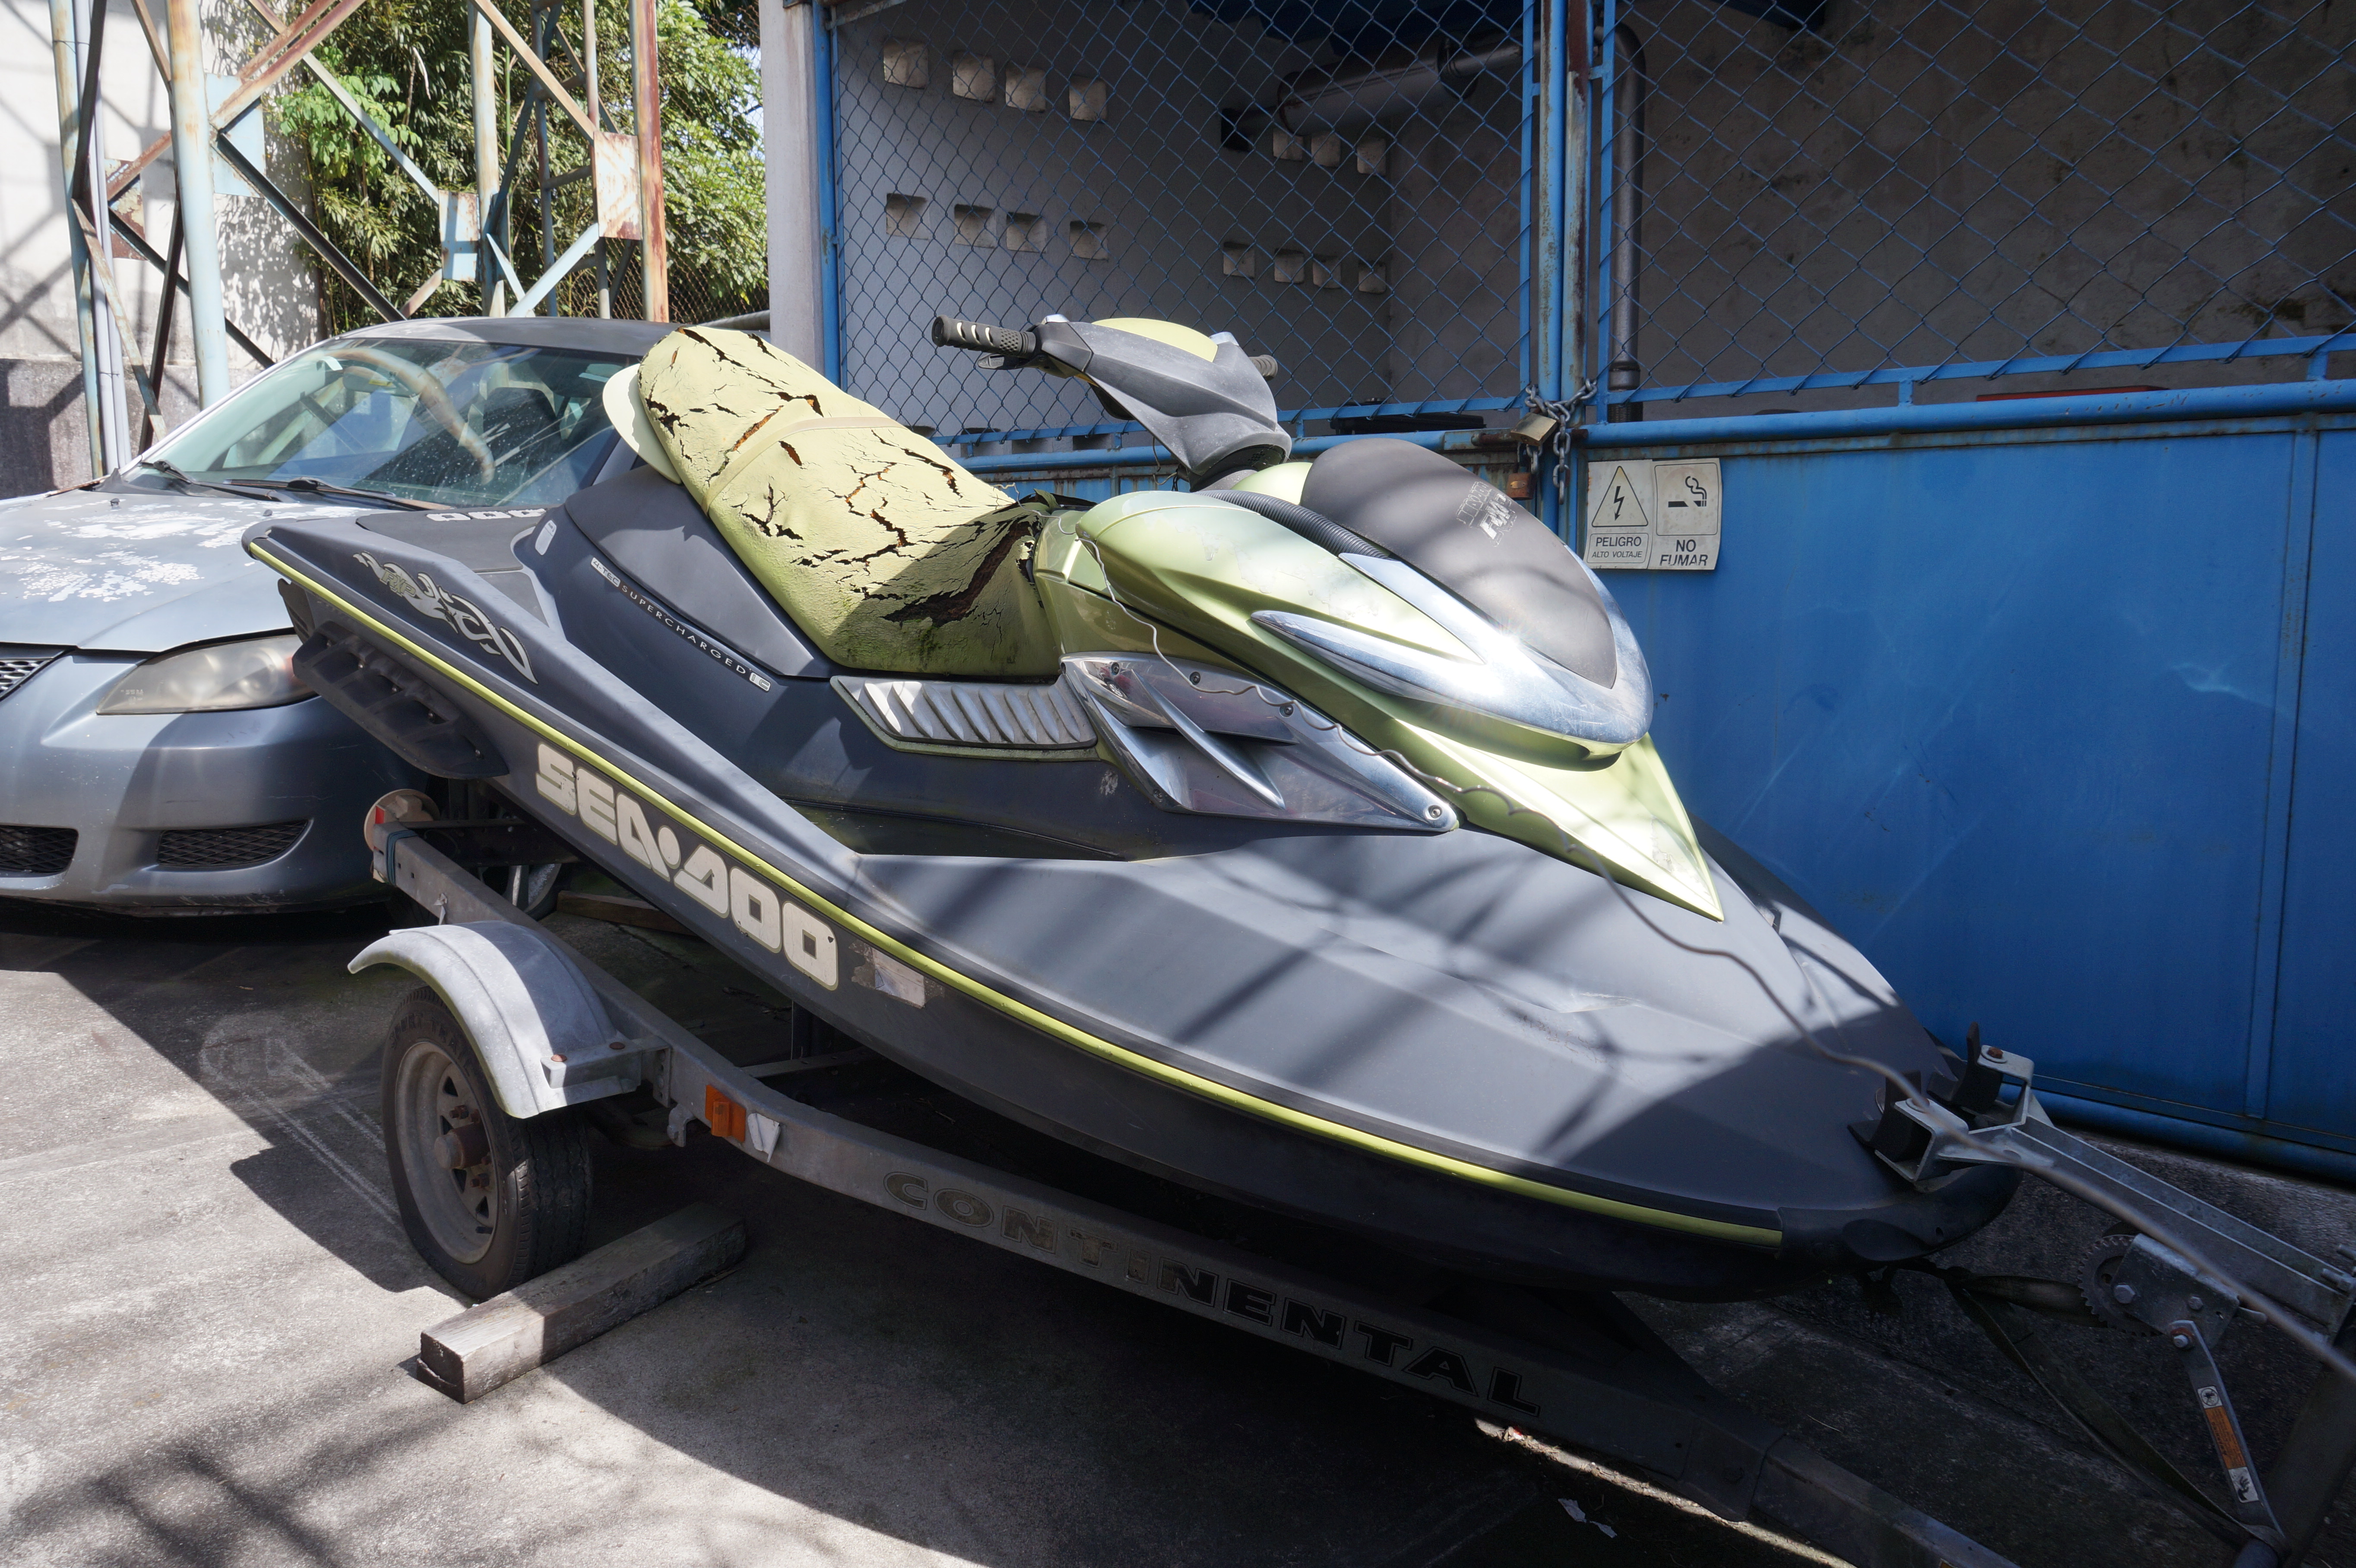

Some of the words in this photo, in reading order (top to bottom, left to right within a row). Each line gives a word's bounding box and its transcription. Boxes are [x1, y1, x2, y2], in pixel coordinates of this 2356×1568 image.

[1596, 536, 1642, 547] PELIGRO
[1675, 539, 1696, 552] NO
[1659, 554, 1708, 566] FUMAR
[380, 571, 417, 597] RXP
[592, 560, 620, 586] 4-TEC
[622, 585, 746, 674] SUPERCHARGED
[883, 1171, 1540, 1417] CONTINENTAL
